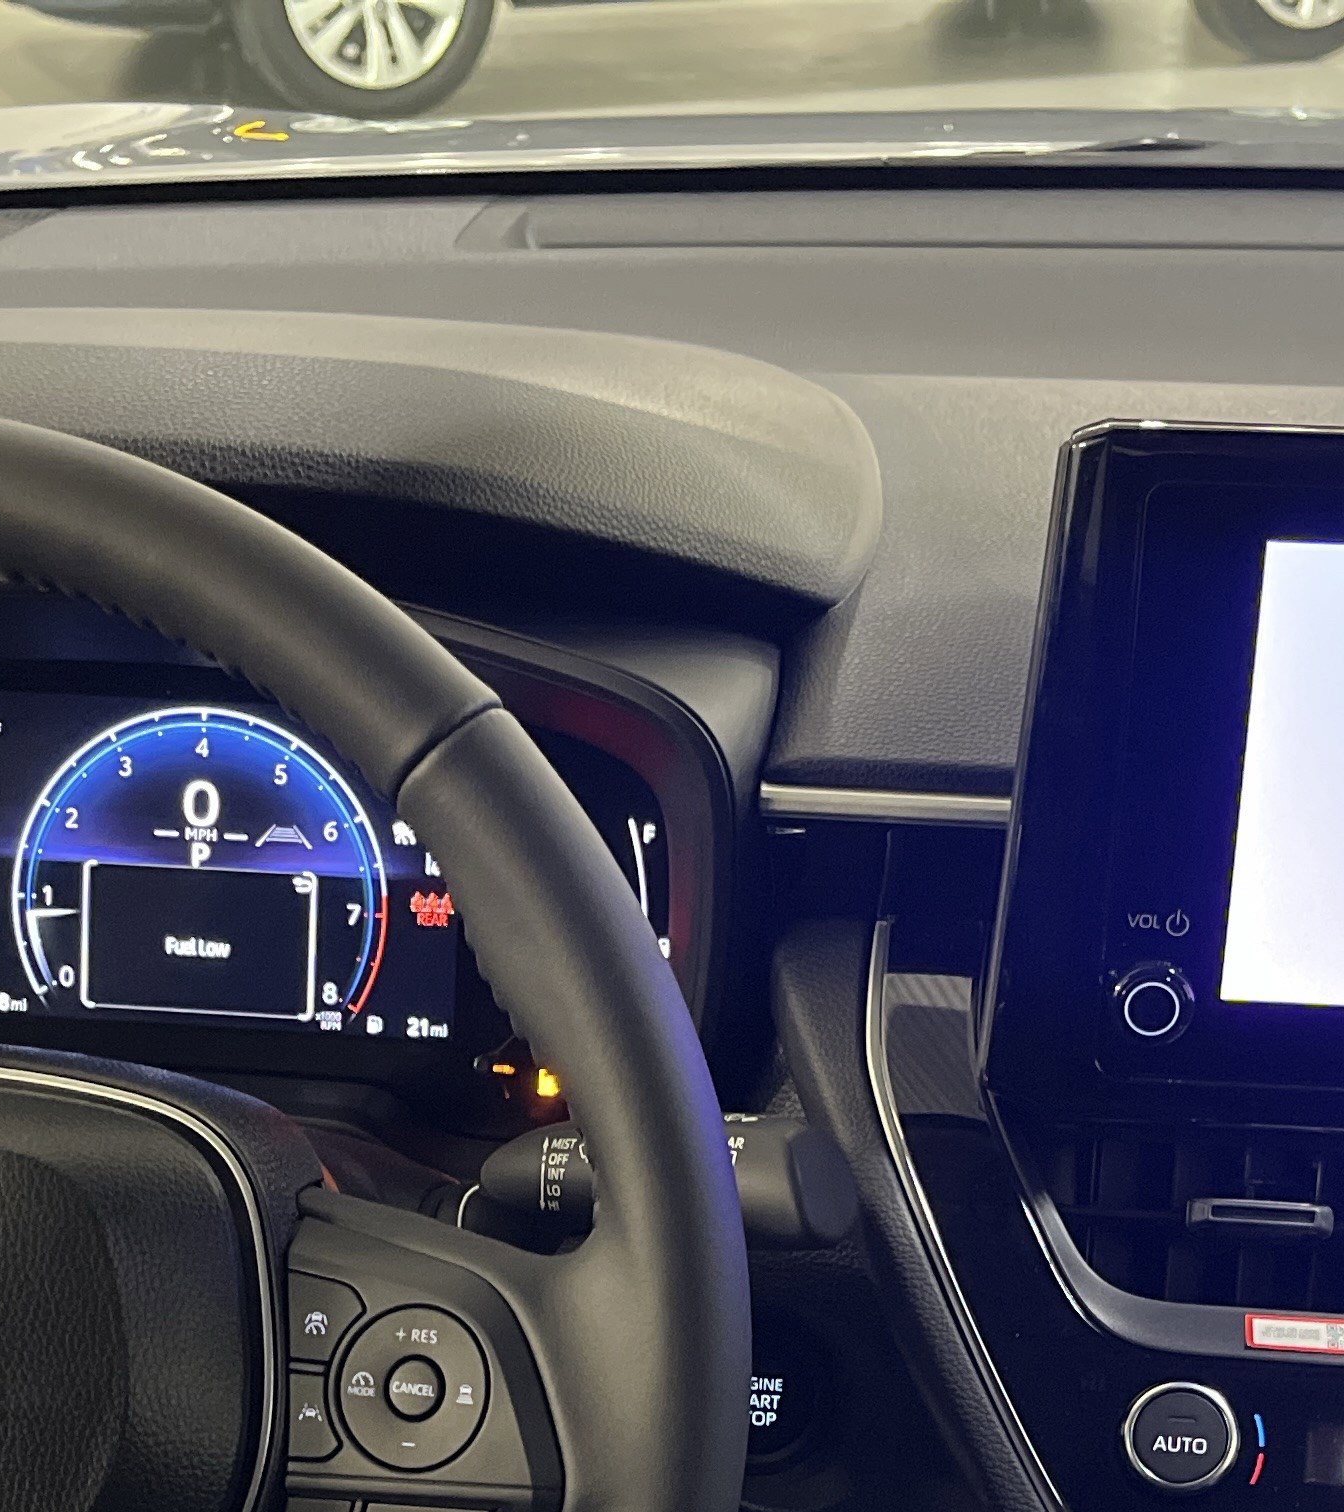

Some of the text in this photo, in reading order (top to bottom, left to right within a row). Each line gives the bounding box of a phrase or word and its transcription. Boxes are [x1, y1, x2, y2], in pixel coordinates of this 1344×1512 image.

[194, 737, 210, 758] 4
[118, 755, 133, 778] 3
[273, 764, 288, 786] 5
[182, 778, 221, 828] 0
[64, 808, 80, 830] 2
[185, 827, 218, 844] MPH
[322, 821, 339, 843] 6
[191, 842, 211, 869] P
[41, 884, 53, 906] 1
[346, 903, 362, 927] 7
[1127, 913, 1160, 930] VOL
[58, 967, 75, 988] 0
[321, 981, 339, 1006] 8
[551, 1137, 577, 1150] MIST
[727, 1136, 745, 1150] AR
[548, 1153, 569, 1166] OFF
[547, 1167, 566, 1181] INT
[411, 1329, 438, 1344] RES
[393, 1380, 434, 1398] CANCEL
[750, 1376, 783, 1392] GINE
[749, 1393, 781, 1410] ART
[749, 1410, 777, 1426] OP
[1153, 1435, 1208, 1456] AUTO
